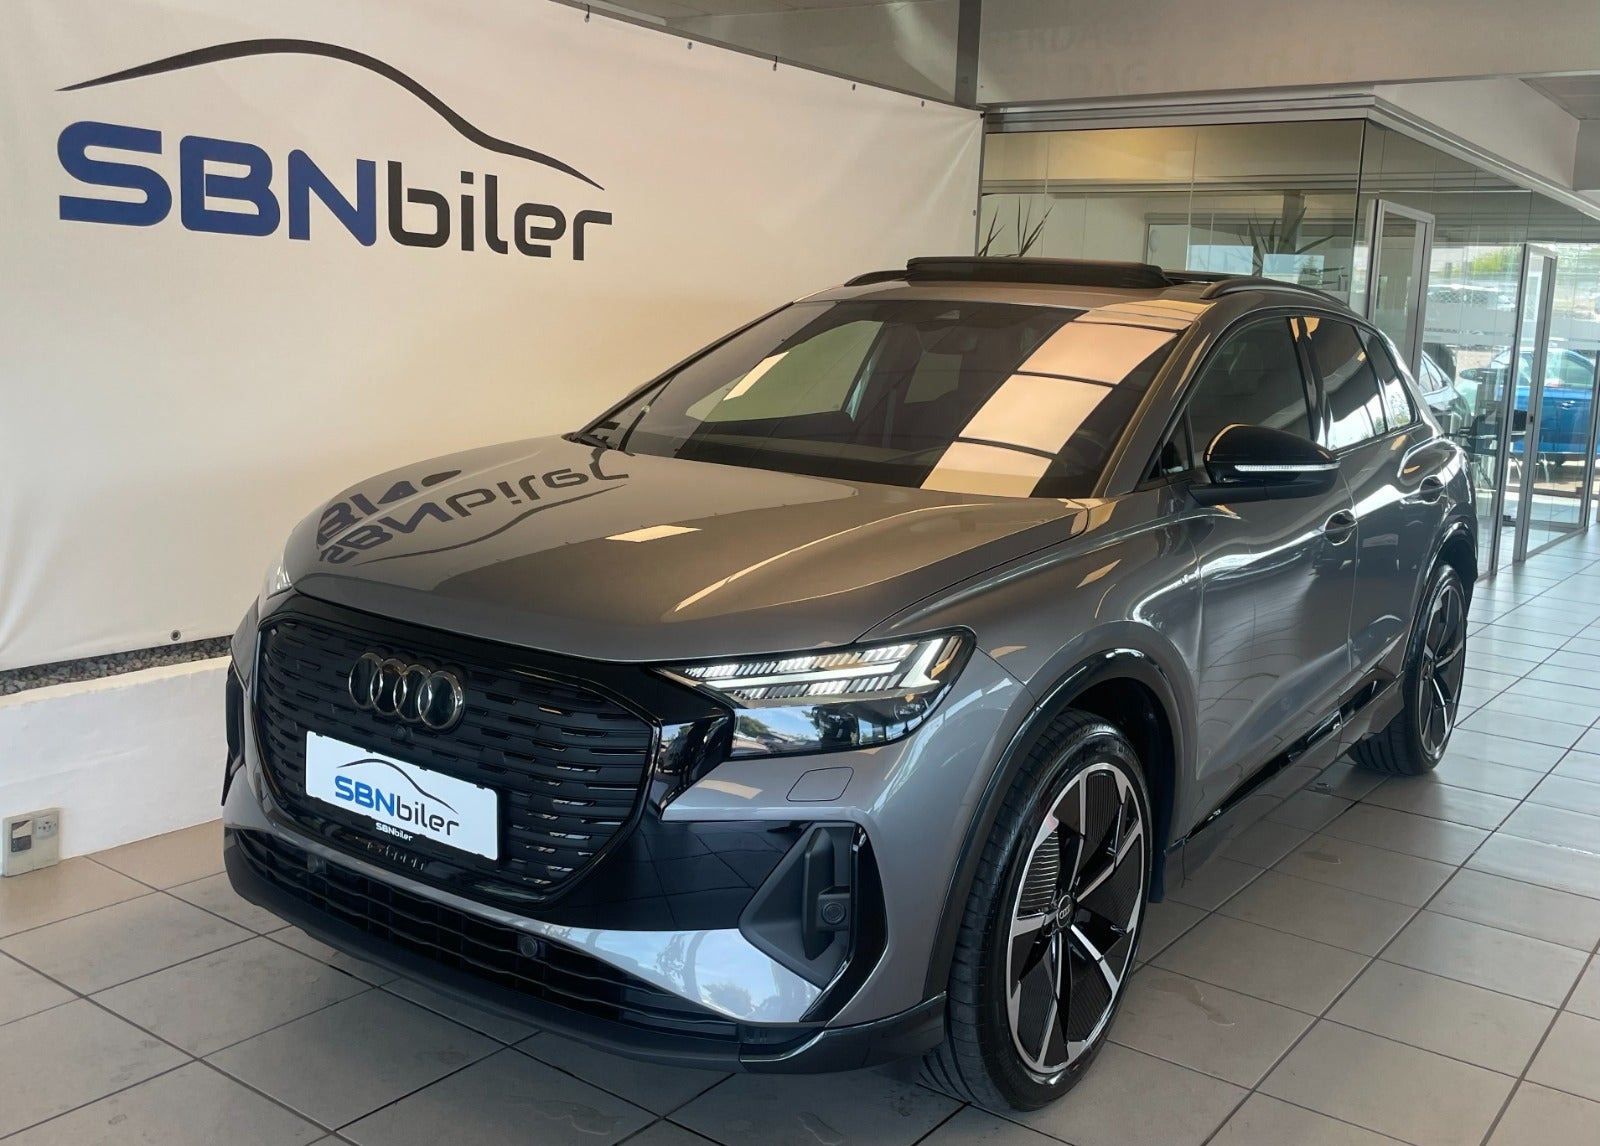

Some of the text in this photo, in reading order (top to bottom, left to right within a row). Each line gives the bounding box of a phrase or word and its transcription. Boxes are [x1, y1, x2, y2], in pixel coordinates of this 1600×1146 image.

[57, 120, 613, 261] SBNbiler
[335, 775, 460, 836] SBNbiler
[375, 822, 413, 841] SBNbiler
